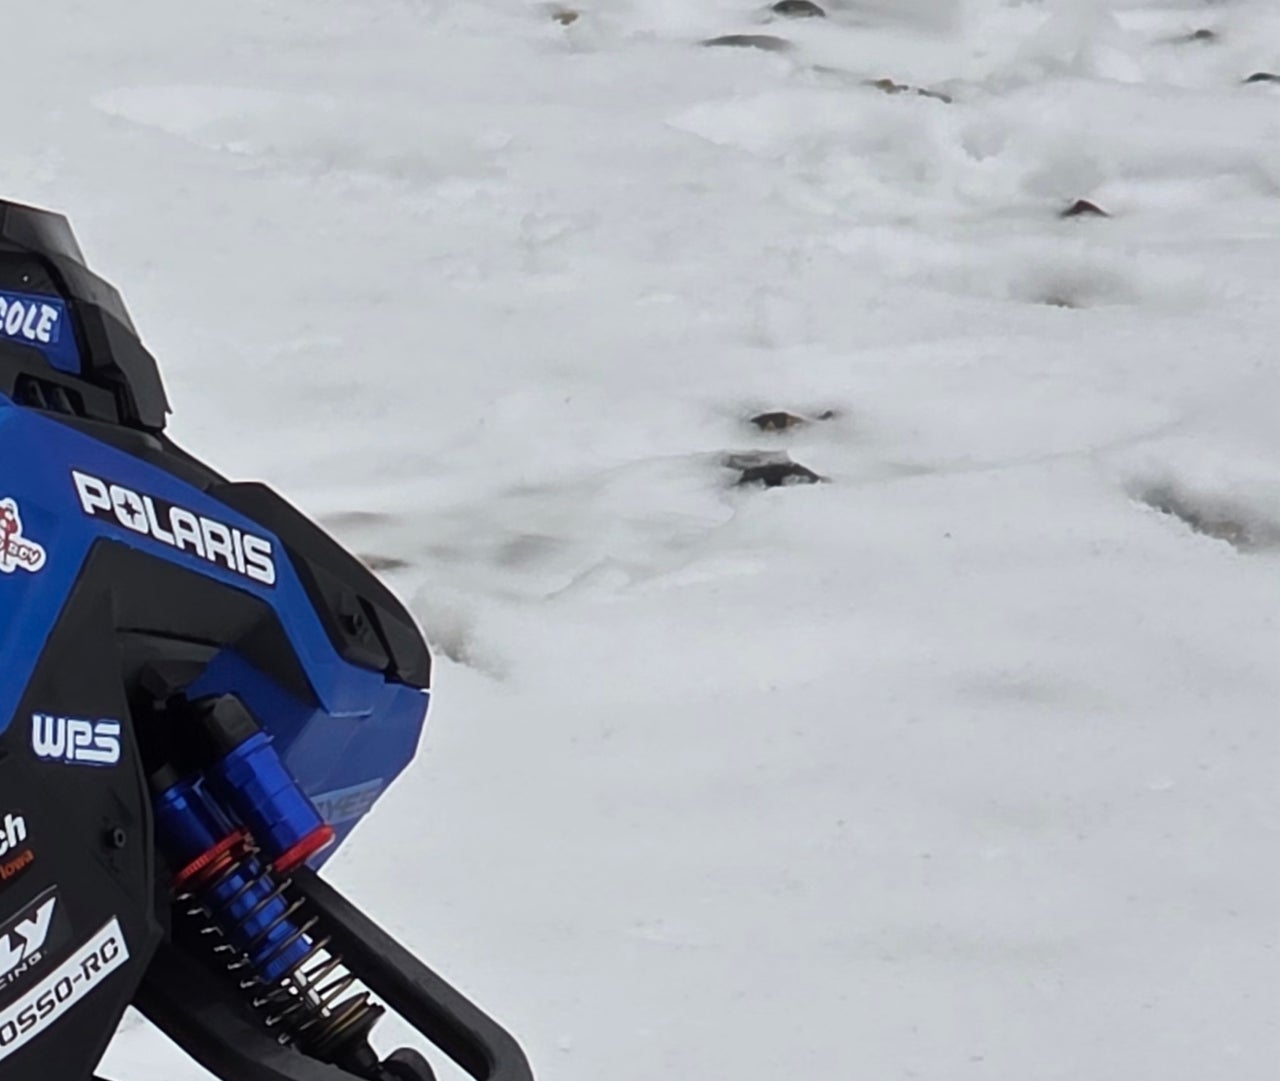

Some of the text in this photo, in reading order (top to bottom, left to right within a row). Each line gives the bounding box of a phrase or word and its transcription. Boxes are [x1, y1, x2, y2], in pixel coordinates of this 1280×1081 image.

[71, 469, 276, 585] POLARIS
[32, 714, 121, 763] WPS
[0, 849, 35, 879] Iowa
